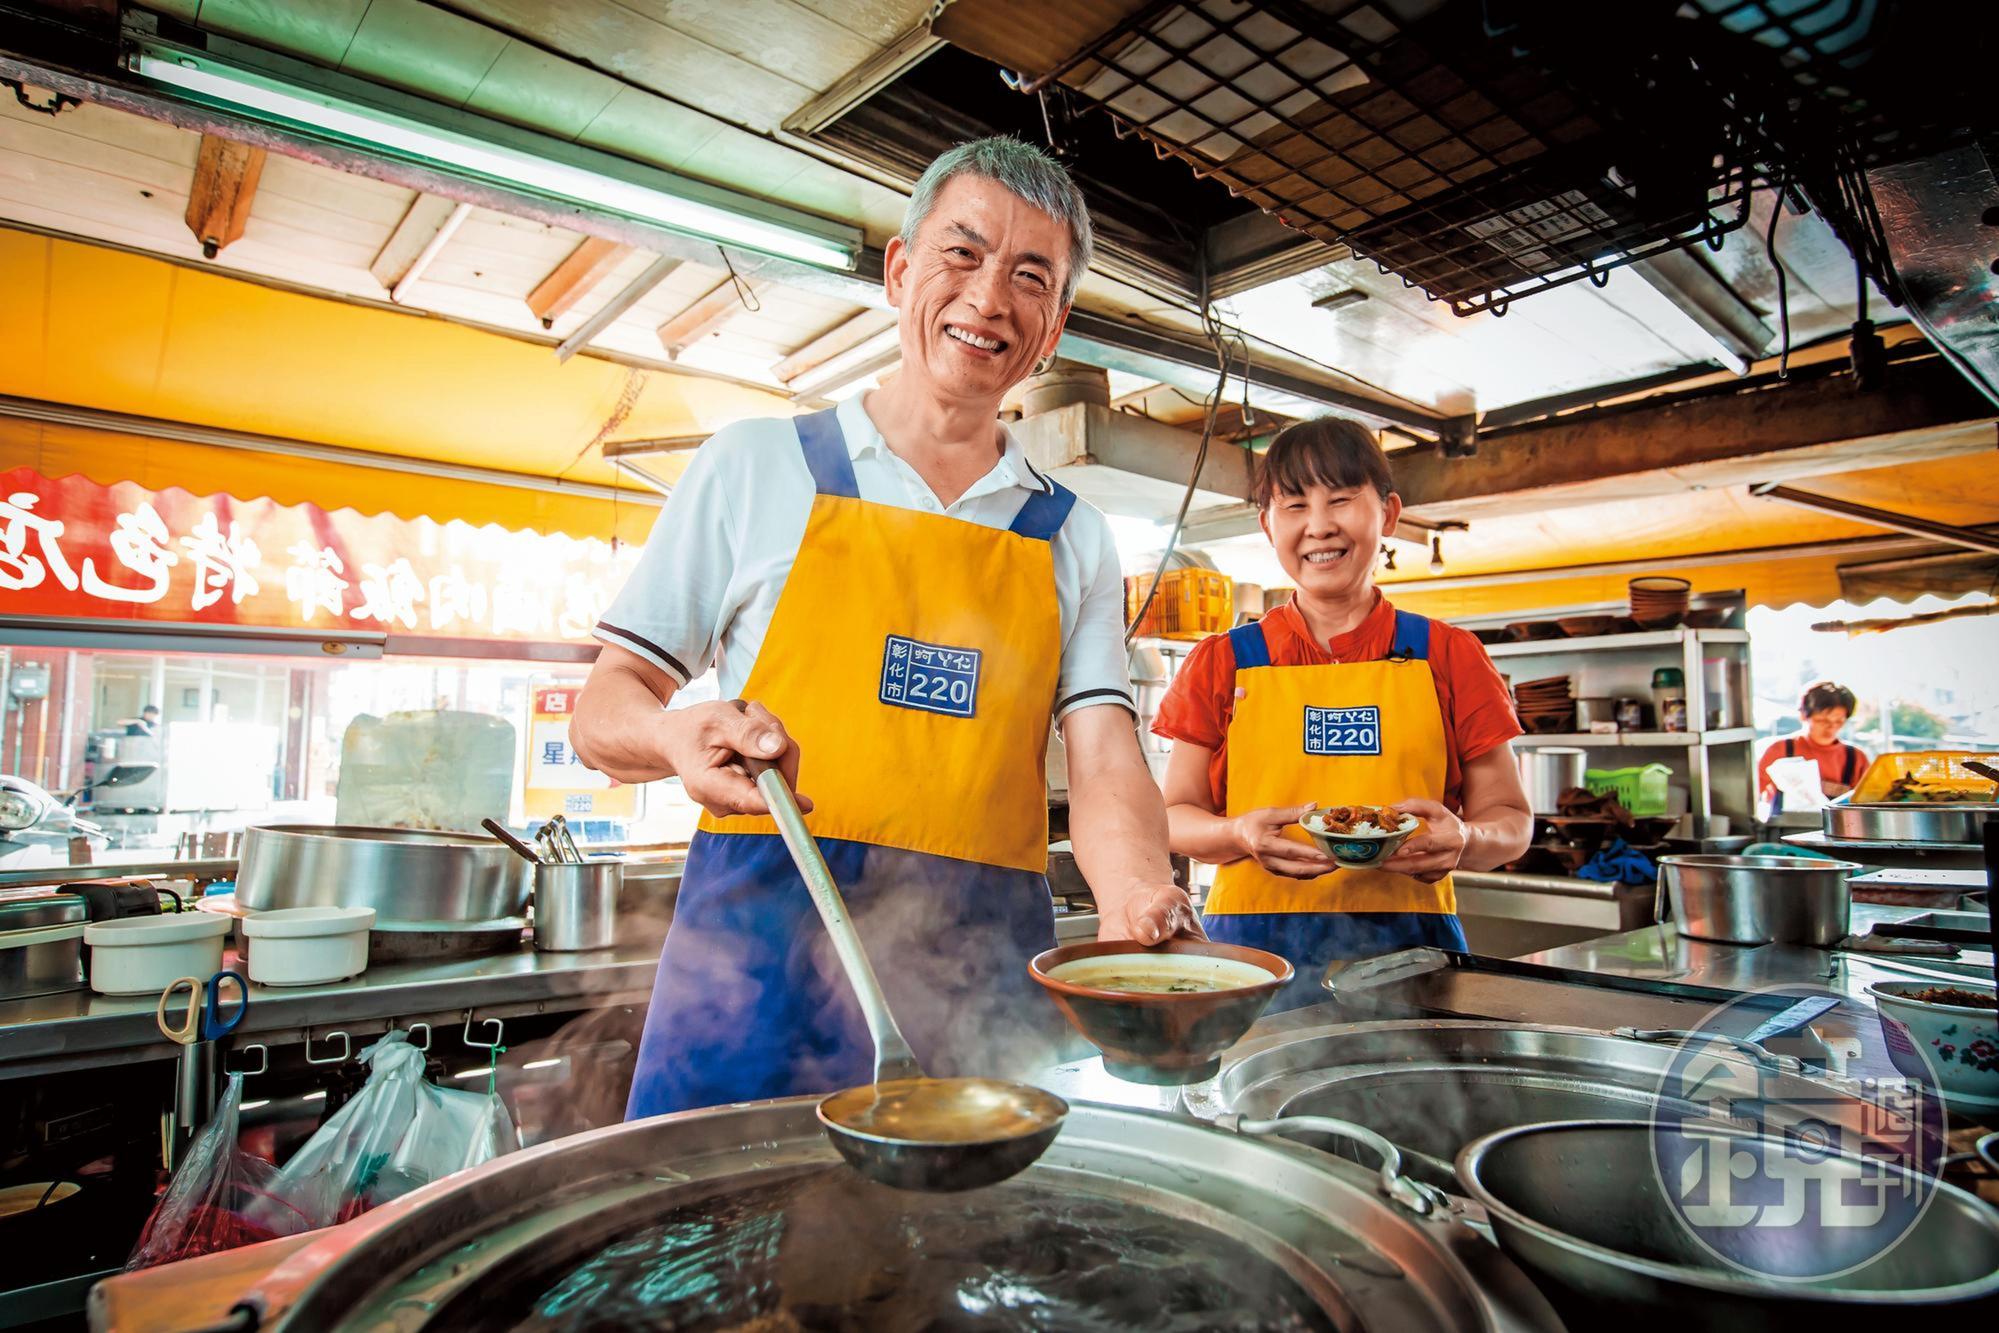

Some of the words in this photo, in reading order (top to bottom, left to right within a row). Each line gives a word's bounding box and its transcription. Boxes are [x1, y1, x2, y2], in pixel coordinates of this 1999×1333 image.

[886, 643, 908, 697] 彰化市
[909, 673, 969, 704] 220
[1309, 711, 1322, 750] 彰化市
[1327, 728, 1375, 746] 220
